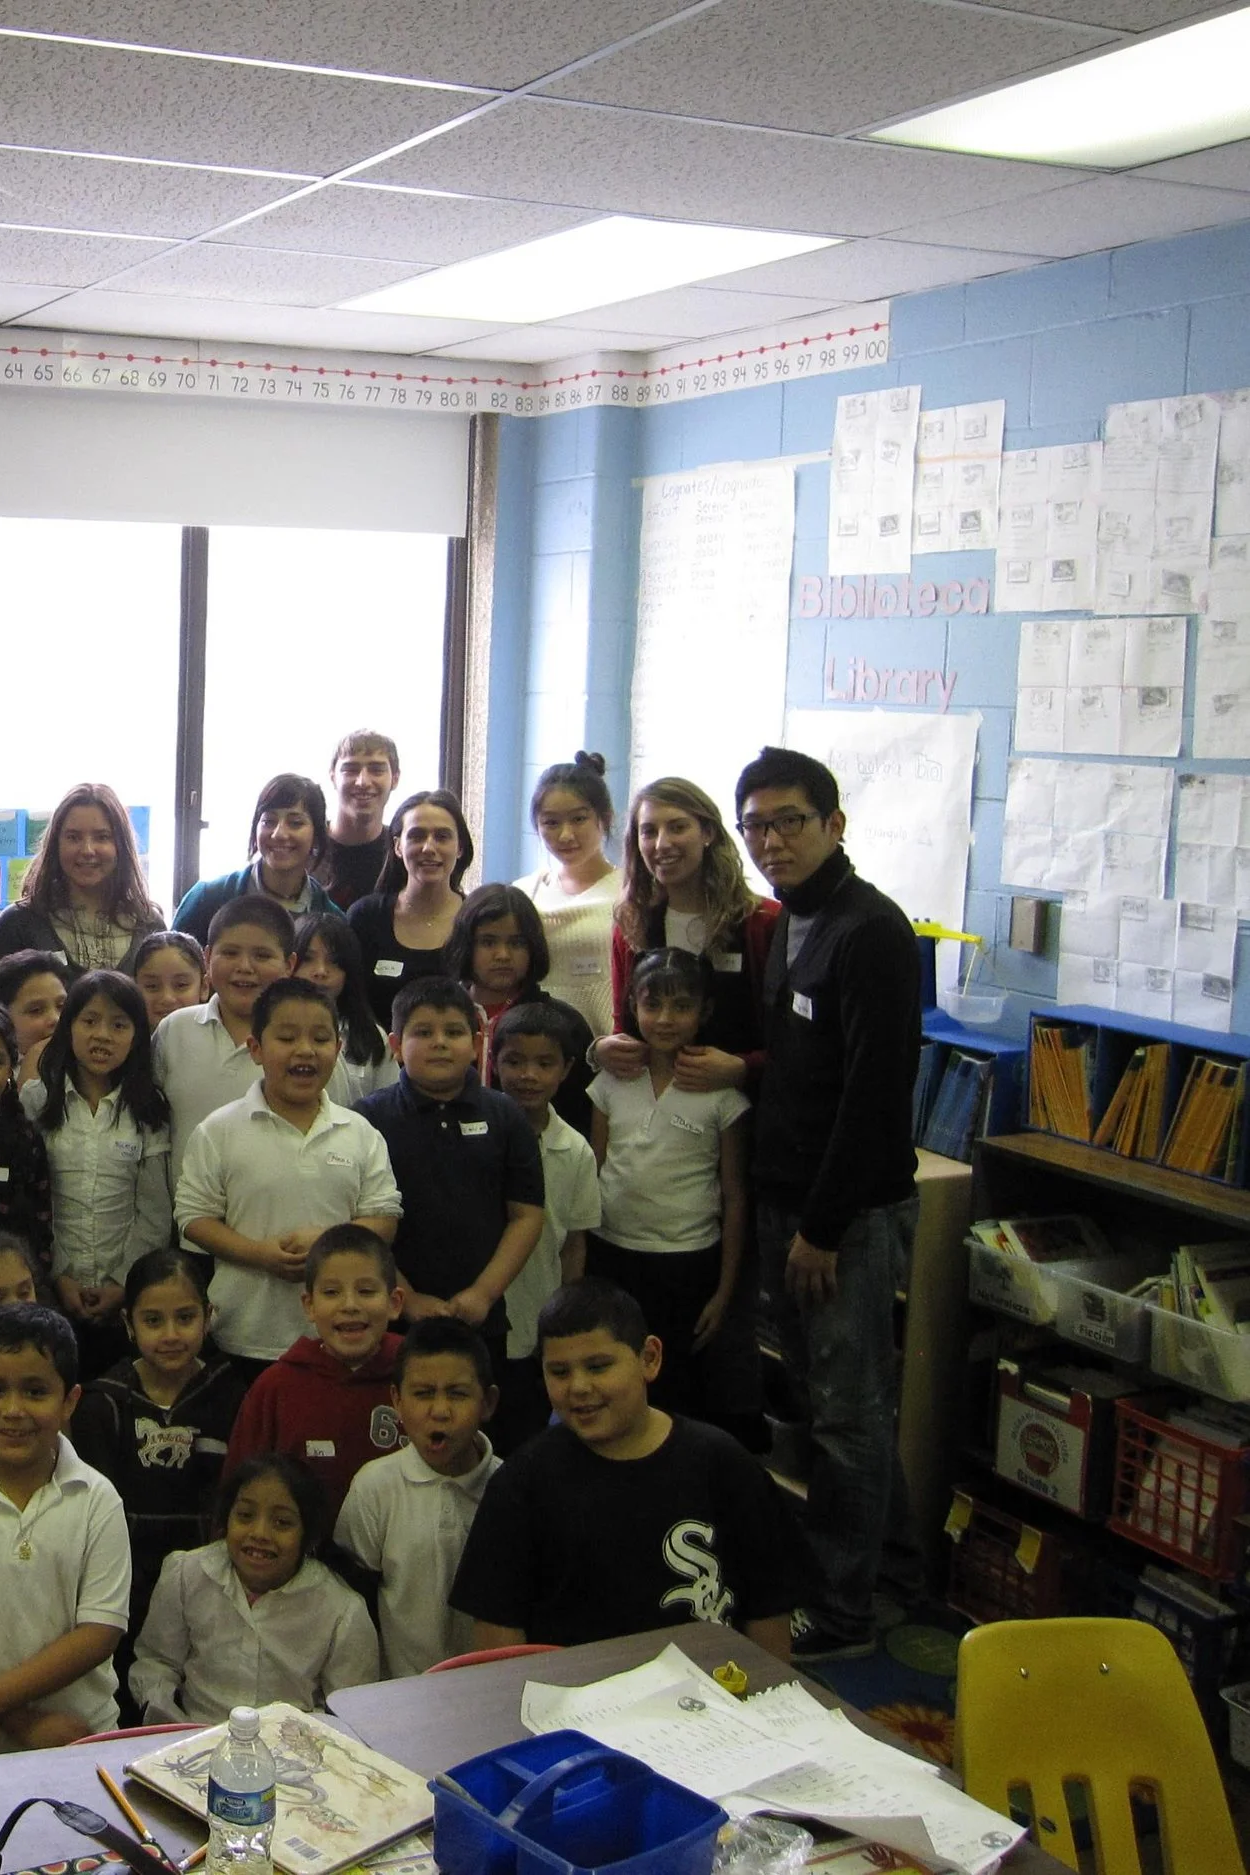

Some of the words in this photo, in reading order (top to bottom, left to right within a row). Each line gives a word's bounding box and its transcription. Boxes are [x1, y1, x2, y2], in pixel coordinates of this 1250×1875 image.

[4, 362, 23, 380] 64
[34, 364, 54, 381] 65
[63, 366, 82, 383] 66
[92, 367, 110, 385] 67
[120, 369, 139, 386] 68
[148, 371, 167, 388] 69
[176, 372, 196, 389] 70
[208, 374, 220, 391] 71
[231, 376, 249, 393] 72
[259, 378, 276, 395] 73
[285, 380, 303, 397] 74
[312, 382, 329, 399] 75
[339, 384, 355, 401] 76
[365, 385, 381, 402] 77
[390, 387, 407, 404] 78
[415, 389, 432, 406] 79
[440, 391, 460, 407] 80
[466, 391, 477, 407] 81
[491, 391, 508, 408] 82
[515, 395, 533, 412] 83
[538, 395, 550, 411] 84
[554, 391, 566, 407] 85
[570, 388, 582, 405] 86
[586, 384, 602, 402] 87
[611, 384, 629, 401] 88
[636, 386, 651, 402] 89
[655, 382, 669, 399] 90
[677, 378, 686, 395] 91
[693, 375, 707, 392] 92
[712, 370, 727, 388] 93
[732, 365, 747, 384] 94
[754, 361, 769, 380] 95
[774, 358, 790, 376] 96
[796, 353, 812, 372] 97
[819, 349, 836, 368] 98
[842, 344, 860, 364] 99
[864, 339, 887, 360] 100
[798, 574, 990, 620] Biblioteca
[825, 656, 958, 714] Library
